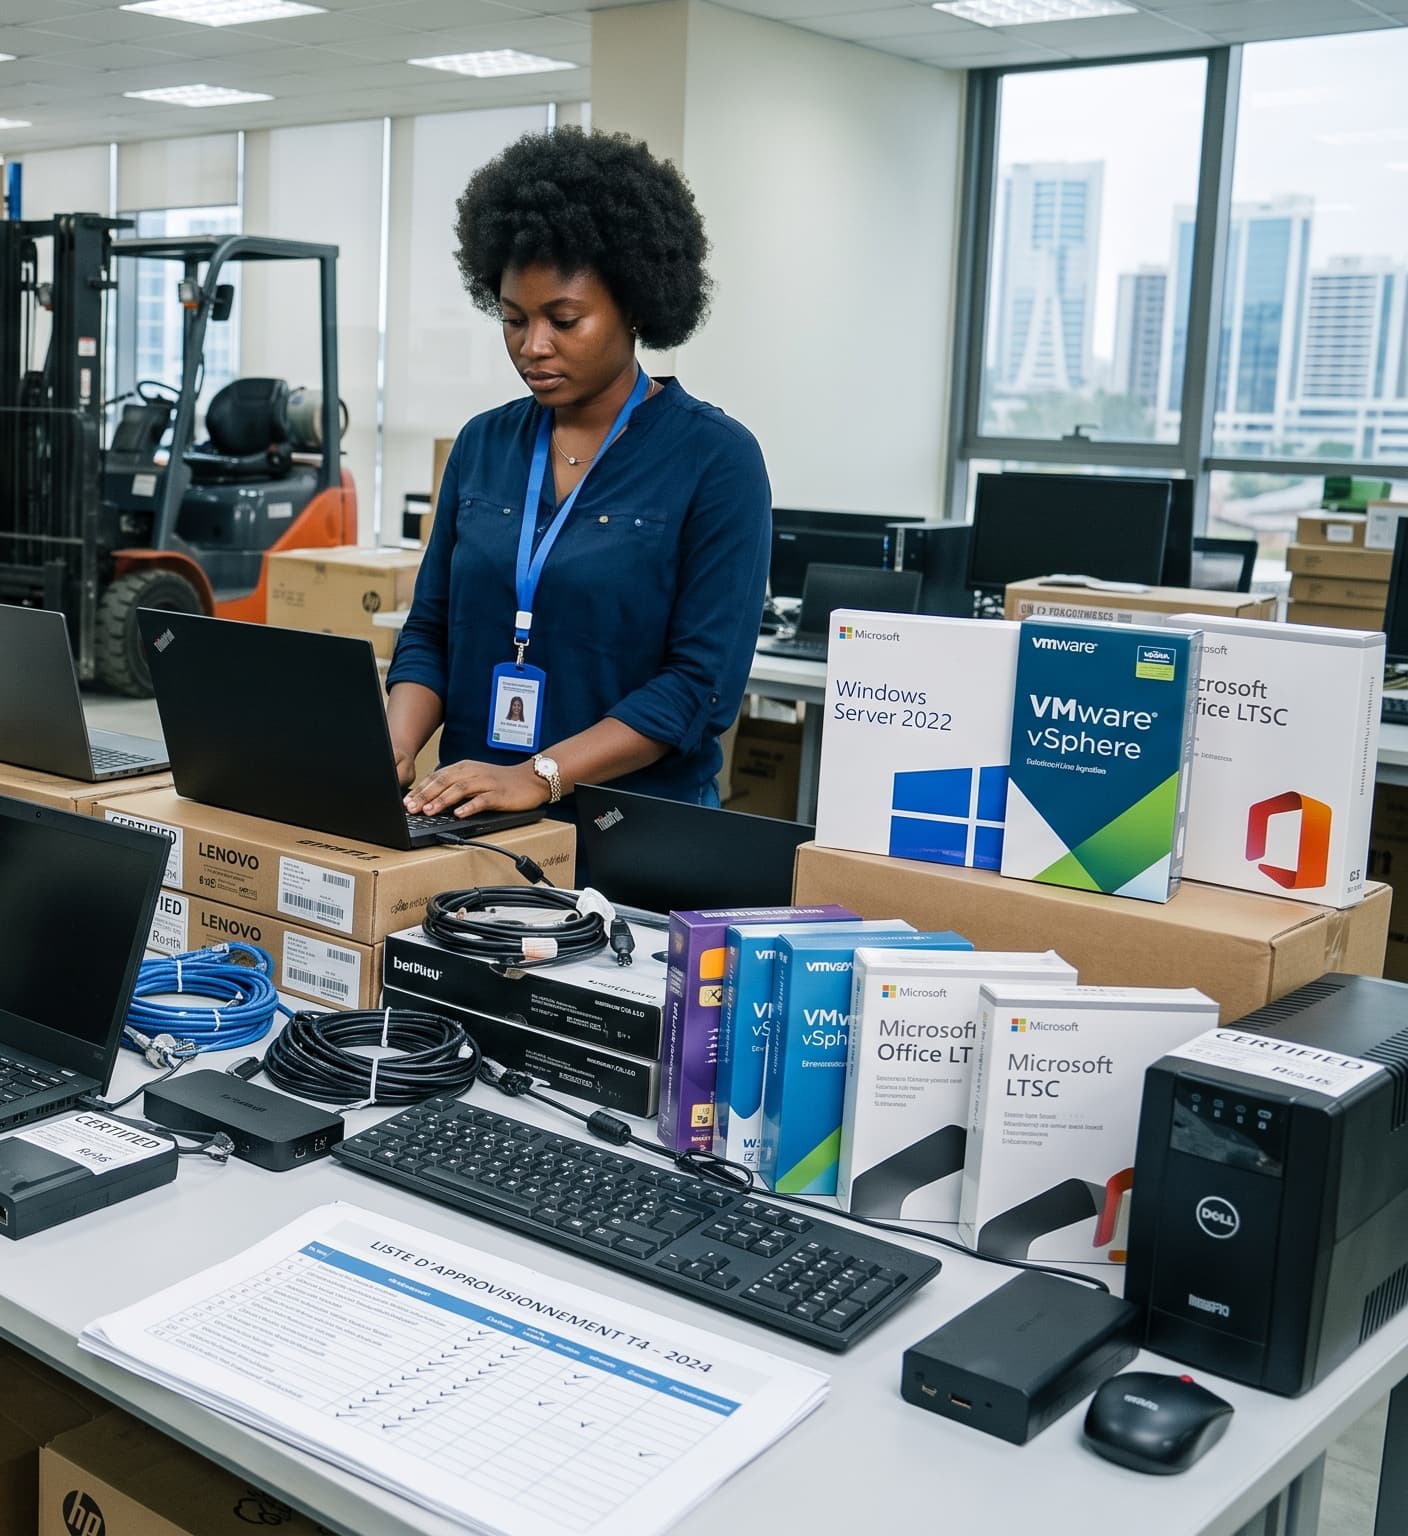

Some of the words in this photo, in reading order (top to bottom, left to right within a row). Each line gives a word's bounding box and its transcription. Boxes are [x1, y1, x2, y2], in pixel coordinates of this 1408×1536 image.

[855, 630, 900, 642] Microsoft
[1032, 637, 1098, 654] vmware
[1200, 645, 1228, 655] rosoft
[836, 679, 927, 705] Windows
[1198, 677, 1268, 700] crosoft
[834, 703, 897, 725] Server
[902, 709, 952, 731] 2022
[1196, 697, 1230, 719] fice
[1237, 703, 1289, 727] LTSC
[1027, 727, 1141, 760] vSphere
[198, 842, 260, 870] LENOVO
[201, 911, 262, 942] LENOVO
[899, 987, 948, 998] Microsoft
[1030, 1021, 1080, 1032] Microsoft
[802, 1030, 848, 1050] vSph
[1216, 1032, 1364, 1070] CERTIFIED
[878, 1043, 942, 1063] Office
[949, 1046, 974, 1064] LT
[1008, 1053, 1113, 1075] Microsoft
[1006, 1078, 1060, 1098] LTSC
[74, 1114, 161, 1150] CERTIFIED
[370, 1241, 415, 1263] LISTE
[414, 1258, 625, 1341] D'APPROVISIONNEMENT
[627, 1335, 651, 1350] T4
[664, 1350, 713, 1374] 2024
